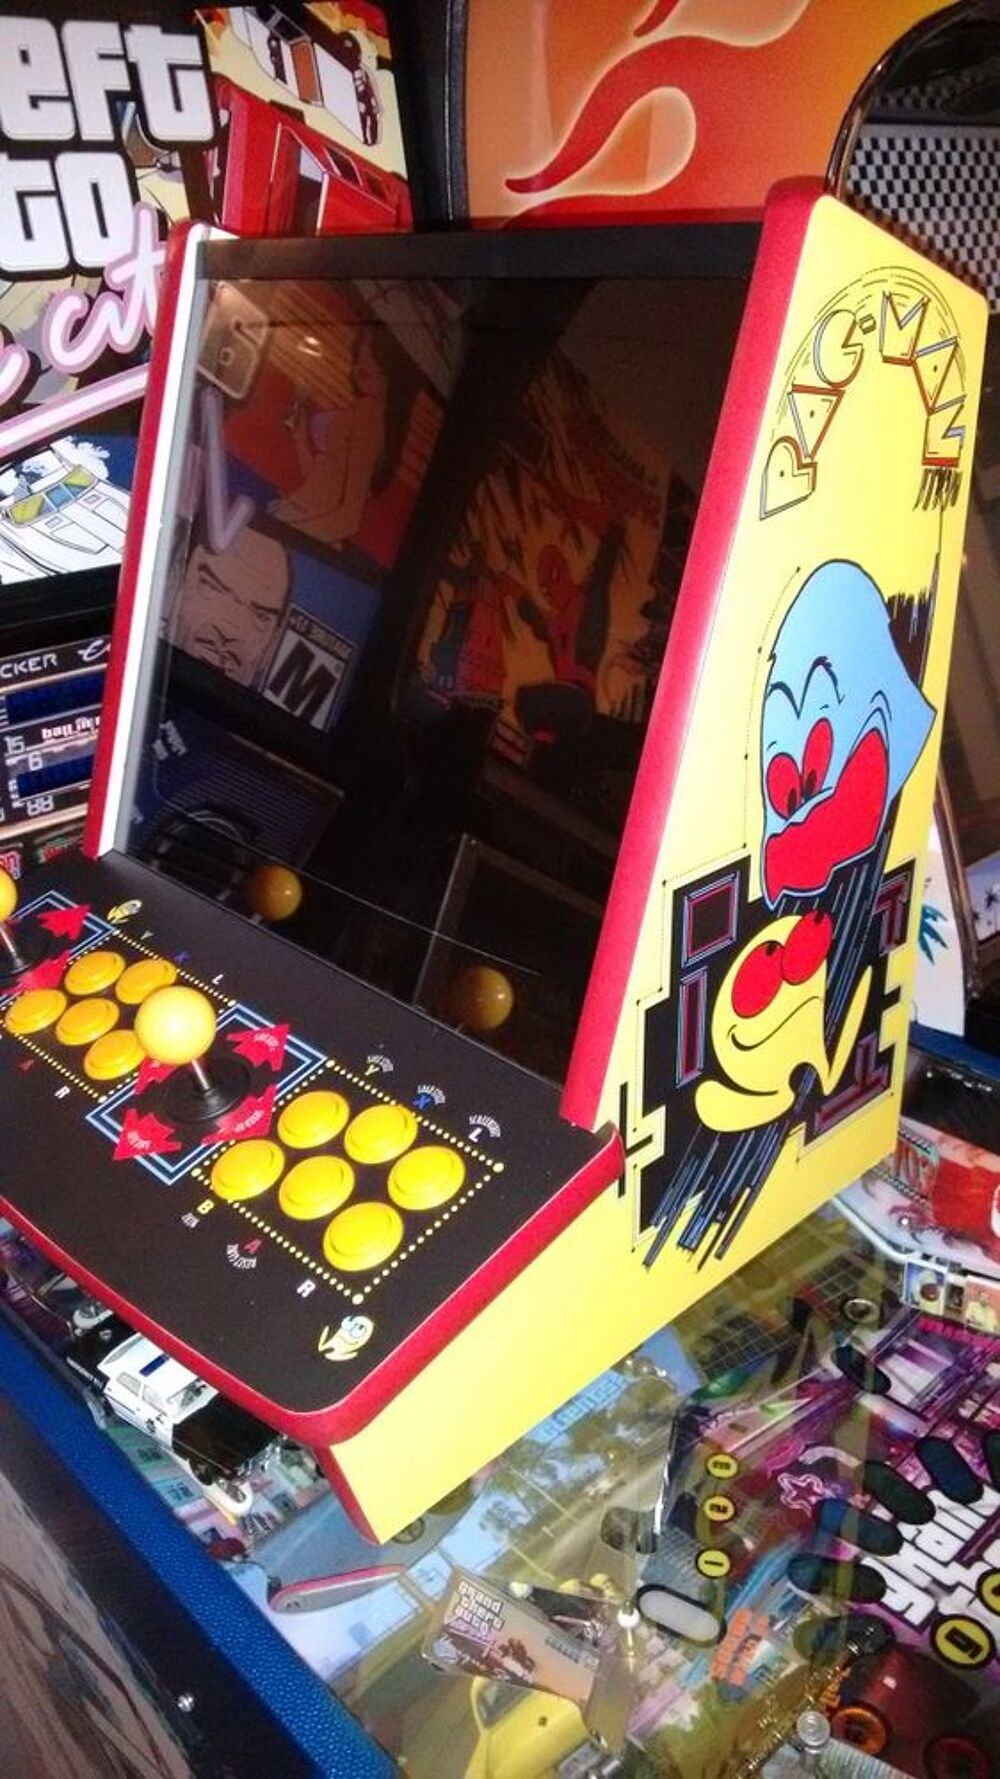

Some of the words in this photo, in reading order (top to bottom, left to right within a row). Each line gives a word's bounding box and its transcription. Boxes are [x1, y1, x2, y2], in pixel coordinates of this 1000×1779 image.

[467, 1126, 483, 1143] L
[196, 1199, 215, 1215] B
[296, 1280, 316, 1298] R
